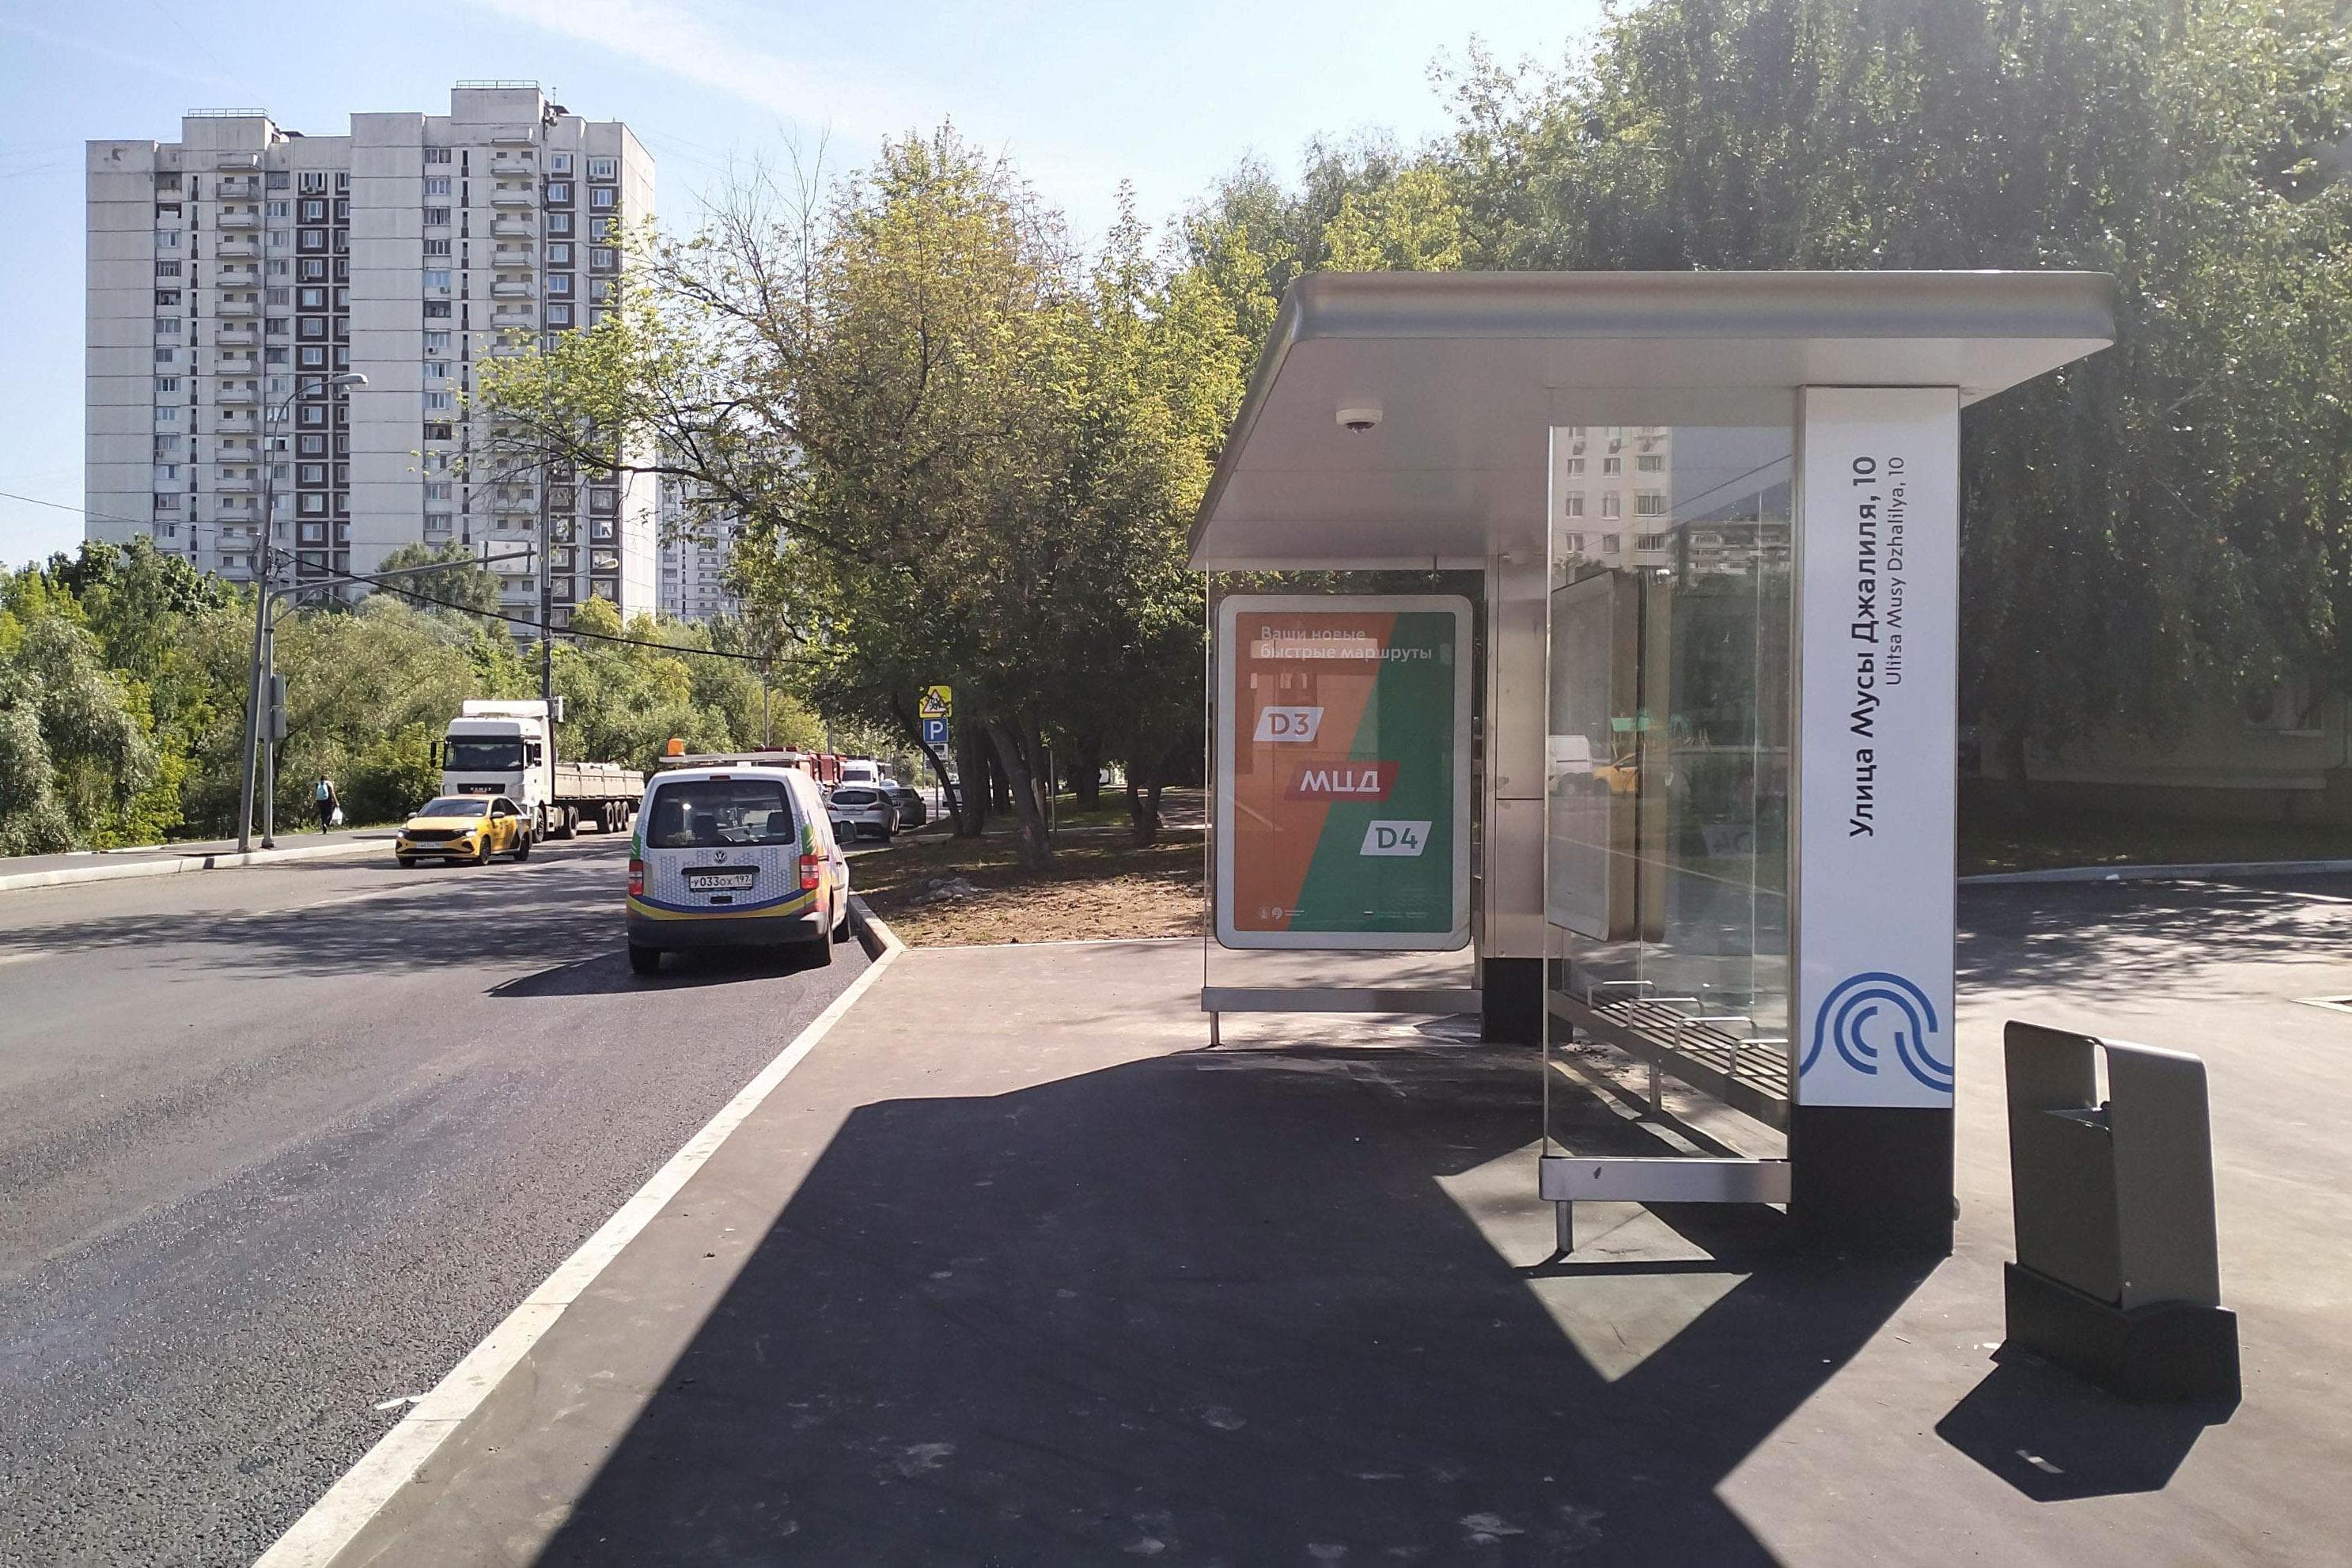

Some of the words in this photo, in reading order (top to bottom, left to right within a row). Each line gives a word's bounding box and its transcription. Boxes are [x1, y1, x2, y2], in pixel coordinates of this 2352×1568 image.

[1852, 456, 1877, 487] 10
[1888, 457, 1904, 476] 10
[1886, 482, 1907, 571] Dzhalilya,
[1851, 495, 1881, 643] Джалиля,
[1886, 577, 1906, 628] Musy
[1261, 626, 1306, 640] Ваши
[1311, 629, 1365, 640] новые
[1260, 643, 1336, 661] быстрые
[1341, 647, 1432, 663] маршруты
[1885, 634, 1902, 685] Ulitsa
[1850, 652, 1880, 738] Мусы
[930, 721, 944, 740] P
[1268, 713, 1310, 736] D3
[1300, 770, 1381, 793] МЦД
[1849, 748, 1877, 837] Улица
[1375, 827, 1418, 849] D4
